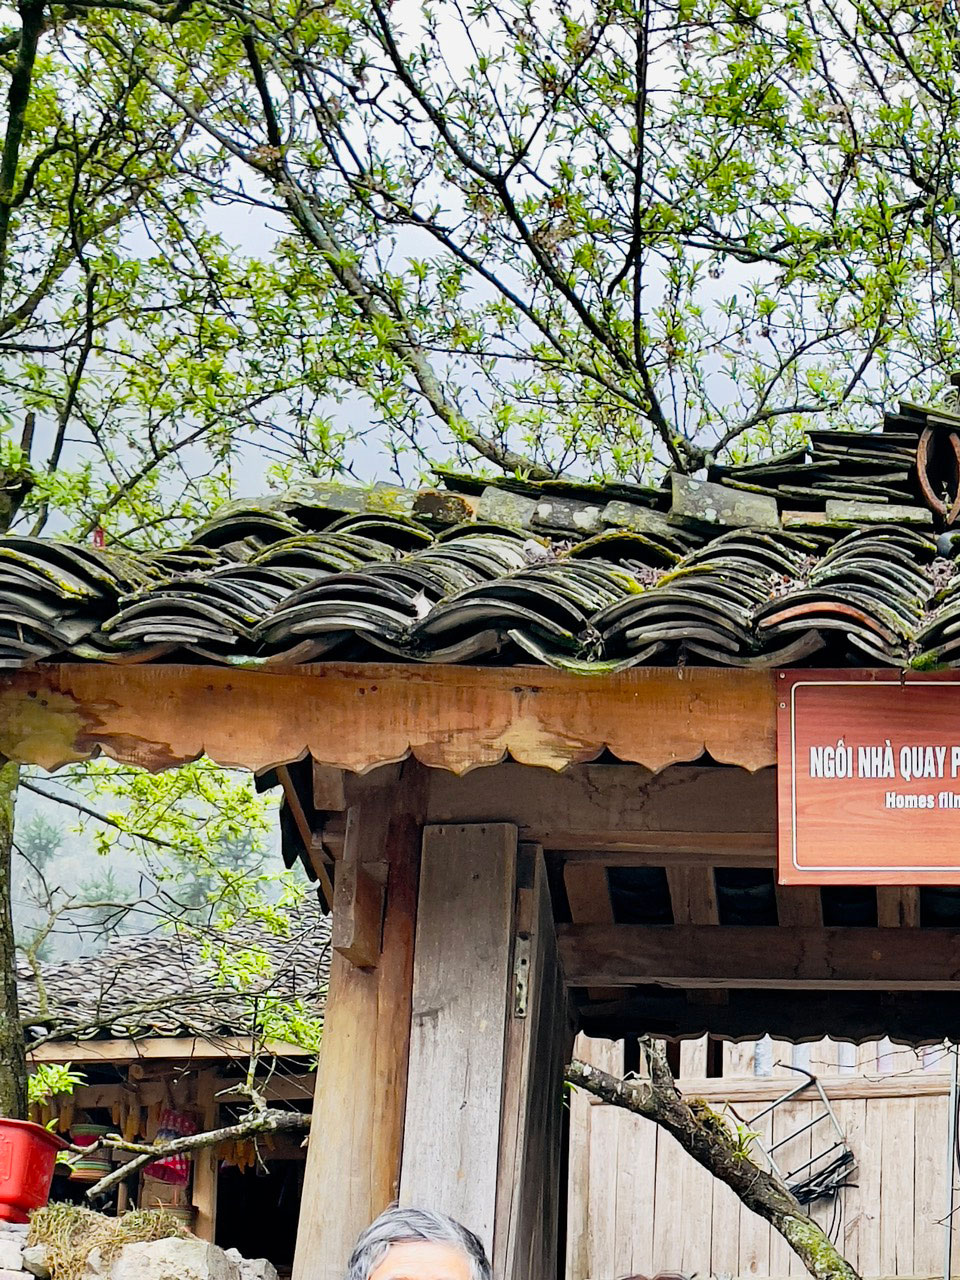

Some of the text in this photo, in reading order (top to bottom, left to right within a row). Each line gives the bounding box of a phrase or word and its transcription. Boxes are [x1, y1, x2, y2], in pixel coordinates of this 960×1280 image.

[809, 739, 853, 778] NGÔI
[857, 739, 896, 778] NHÀ
[899, 745, 947, 782] QUAY
[885, 791, 935, 809] Homes
